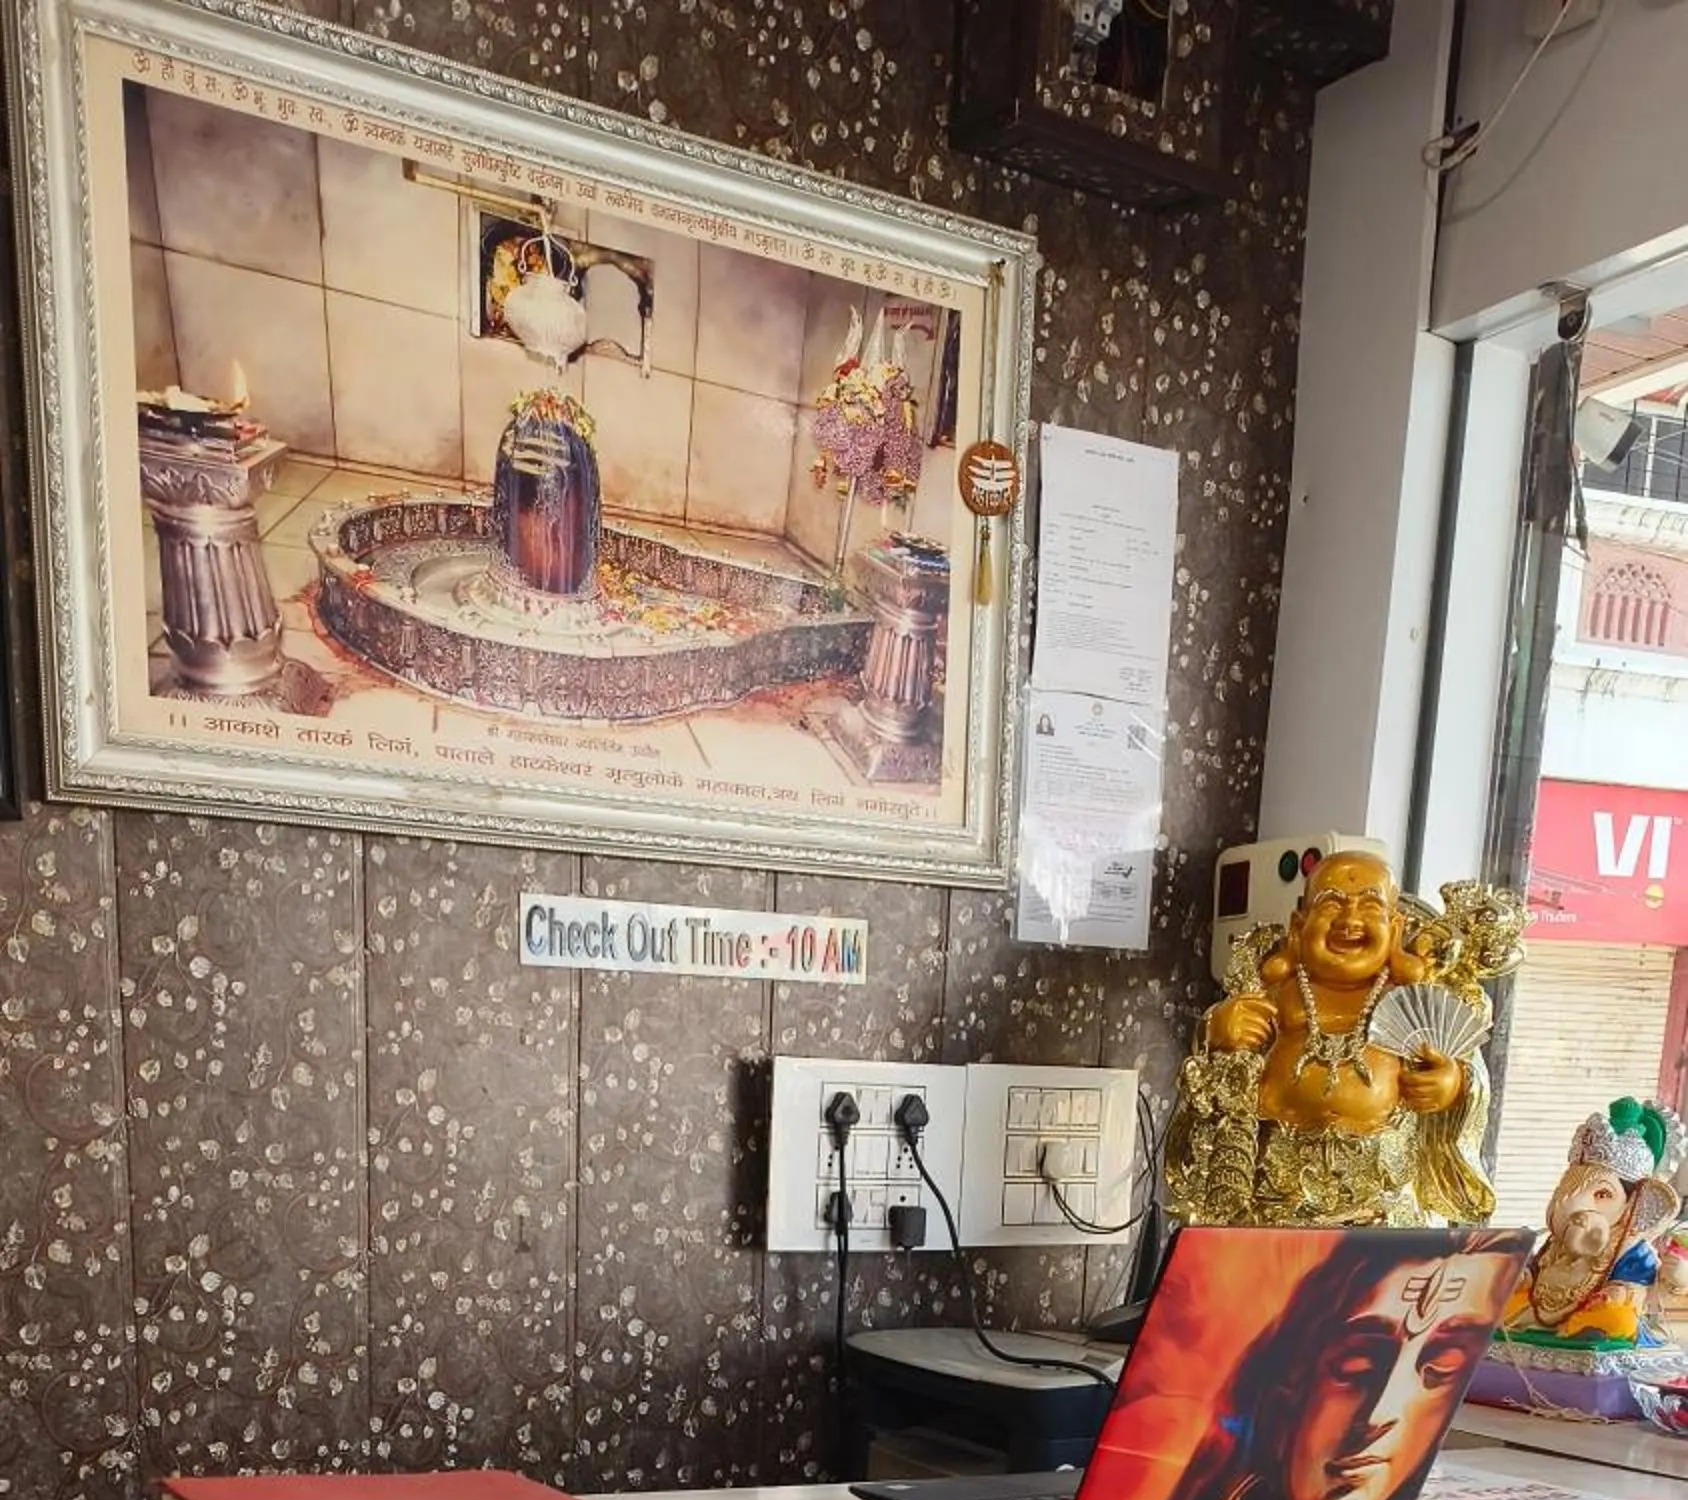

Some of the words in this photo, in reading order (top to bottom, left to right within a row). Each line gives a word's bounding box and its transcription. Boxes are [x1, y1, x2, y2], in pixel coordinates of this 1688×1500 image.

[204, 716, 281, 739] आकाशे
[296, 727, 353, 747] तारकं
[434, 742, 496, 767] पाताले
[1593, 811, 1673, 880] VI
[525, 904, 619, 961] Check
[626, 913, 679, 965] Out
[685, 917, 752, 968] Time
[786, 925, 816, 973] 10
[821, 927, 866, 975] AM
